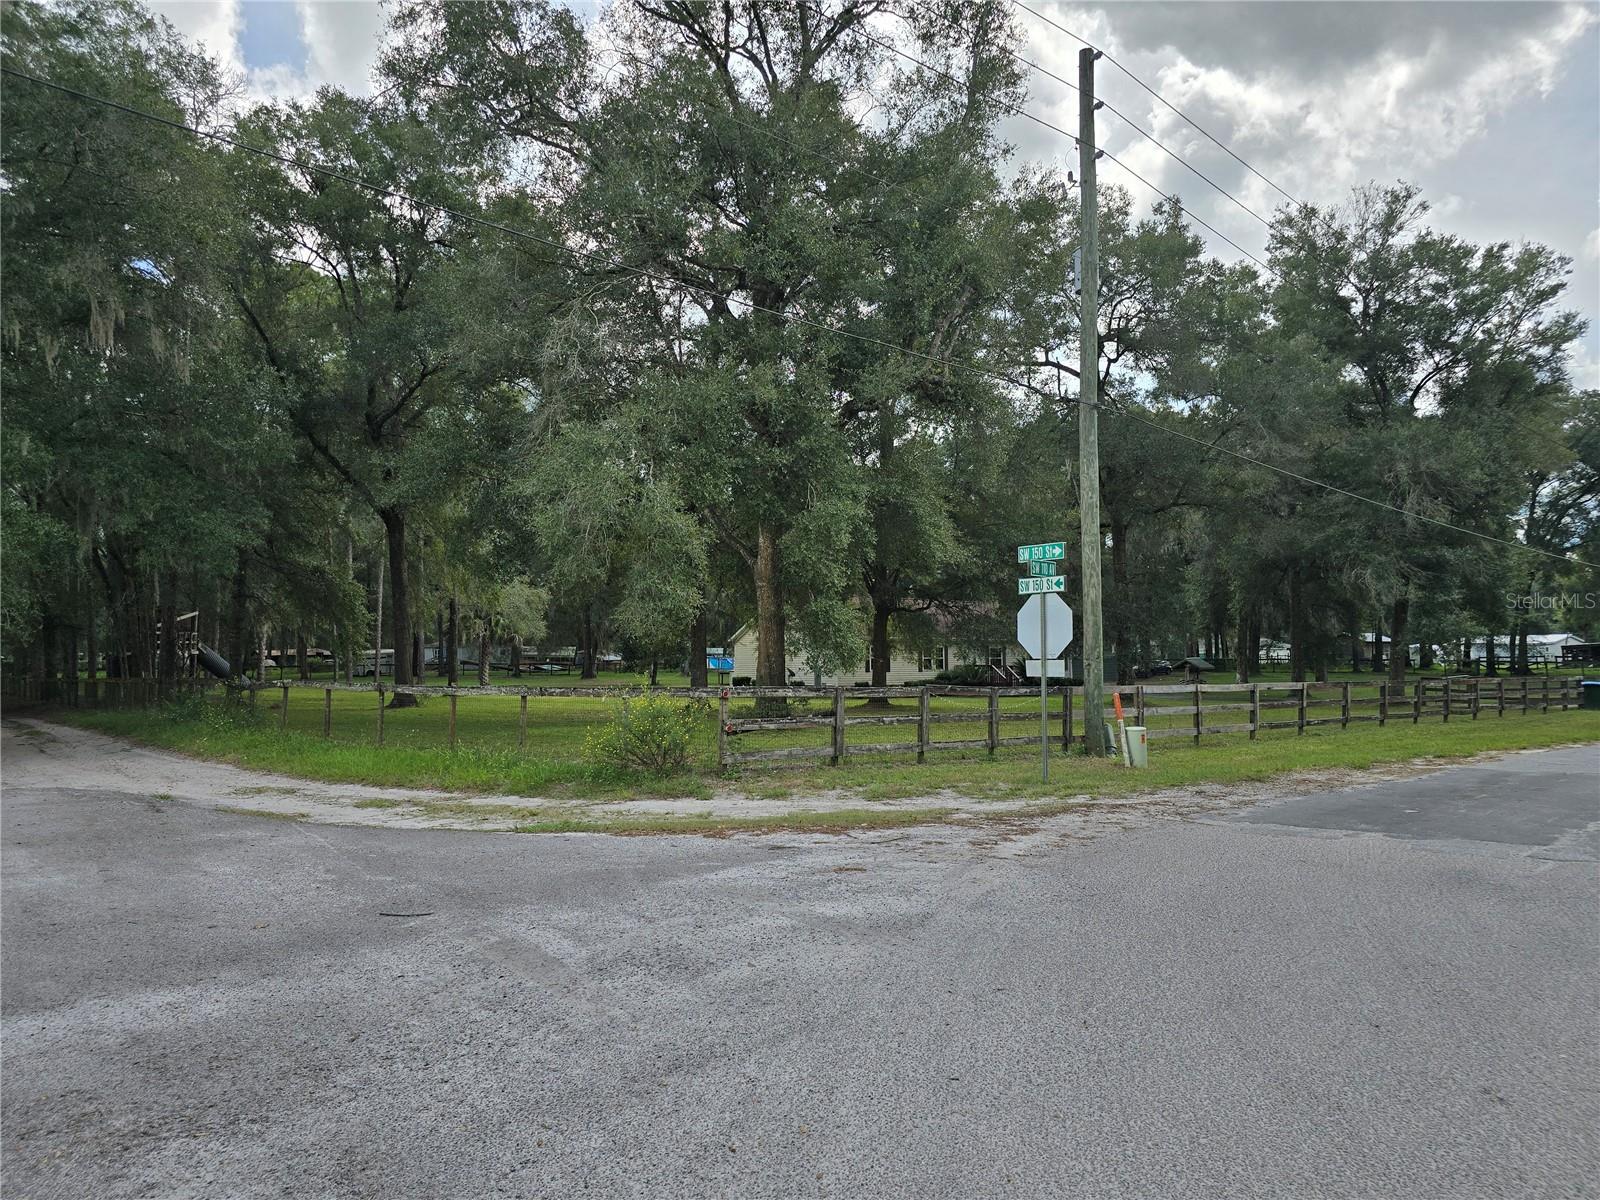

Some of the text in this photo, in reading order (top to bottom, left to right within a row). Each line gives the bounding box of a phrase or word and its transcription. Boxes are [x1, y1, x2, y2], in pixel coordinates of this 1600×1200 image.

[1019, 546, 1052, 560] SW 150 St
[1032, 562, 1040, 573] SW
[1020, 579, 1053, 592] SW 150 St
